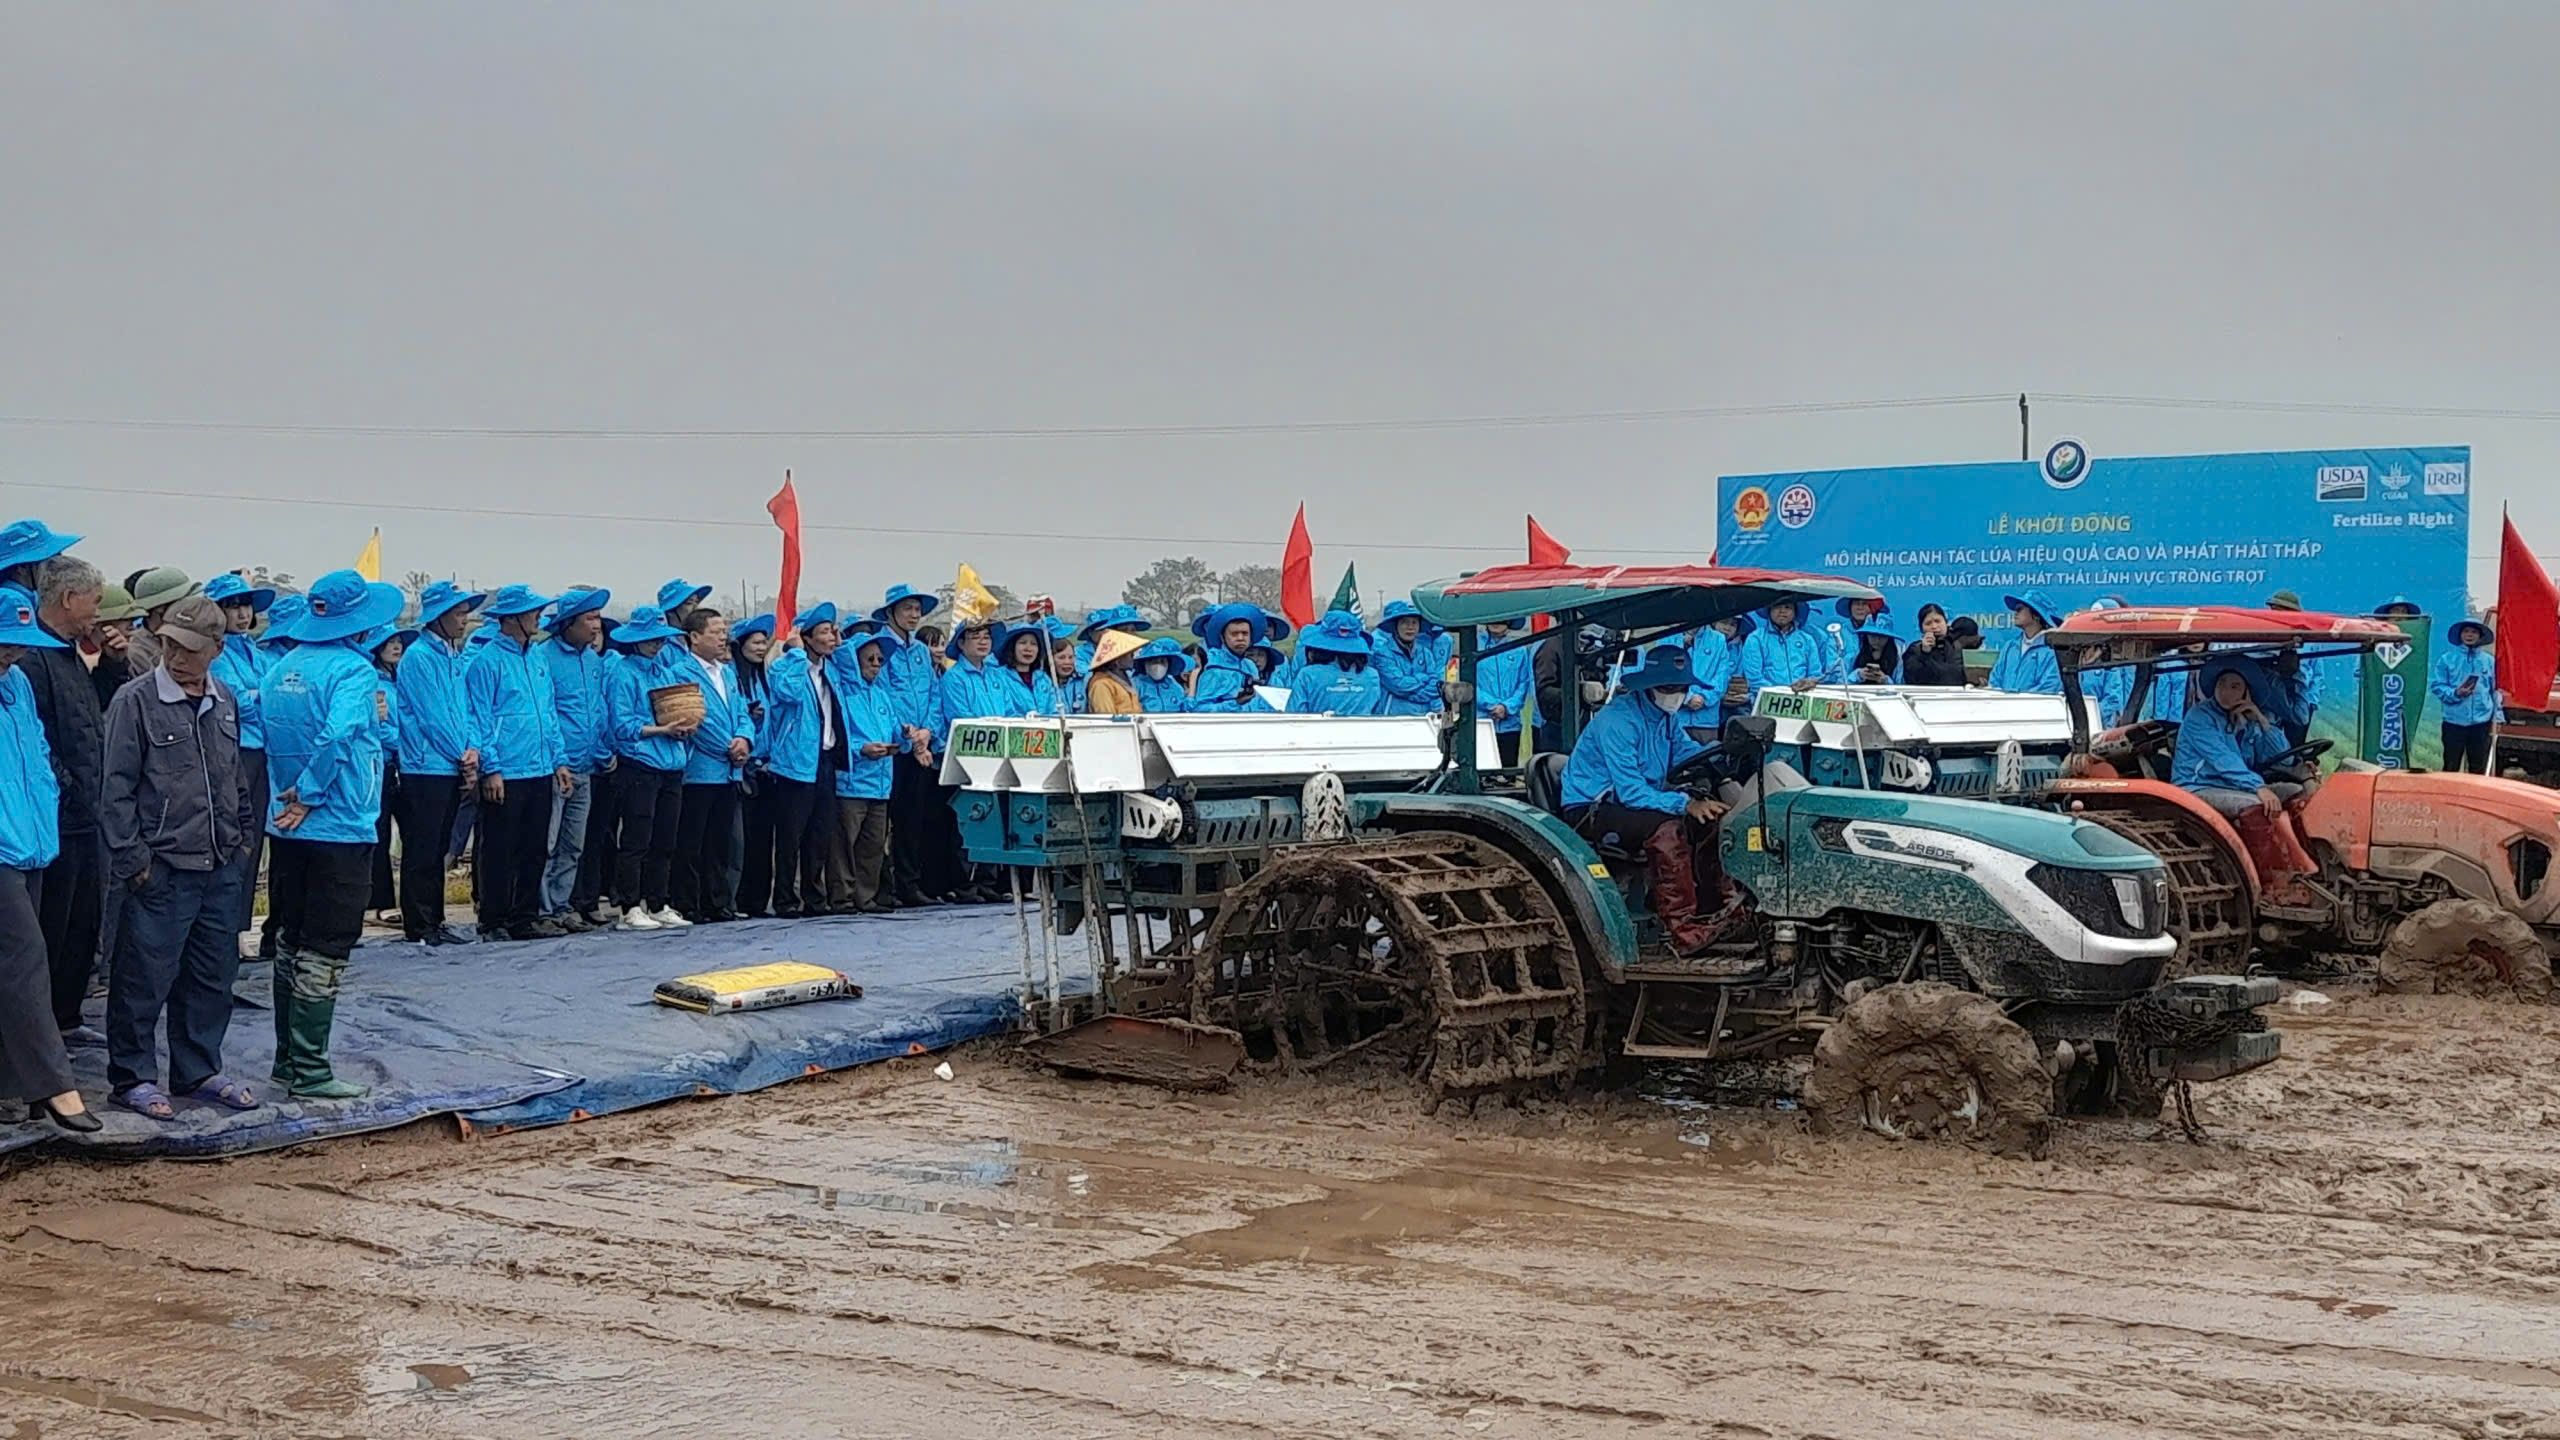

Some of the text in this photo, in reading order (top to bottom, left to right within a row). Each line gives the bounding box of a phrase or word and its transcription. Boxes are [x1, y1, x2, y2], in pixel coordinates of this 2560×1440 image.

[2320, 469, 2365, 482] USDA
[2428, 472, 2462, 486] IRRI
[1988, 512, 2131, 537] LỄ KHỞI ĐỘNG
[2332, 511, 2454, 528] Fertilize Right
[1824, 550, 1849, 566] MÔ
[1854, 549, 1894, 566] HÌNH
[1898, 551, 1942, 565] CANH
[1948, 547, 1976, 564] TÁC
[1981, 546, 2012, 563] LÚA
[2017, 545, 2057, 565] HIỆU
[2062, 543, 2099, 564] QUẢ
[2104, 546, 2140, 561] CAO
[2145, 542, 2167, 561] VÀ
[2173, 542, 2218, 560] PHÁT
[1887, 572, 1905, 587] ÁN
[2018, 570, 2053, 585] PHÁT
[2227, 569, 2266, 586] TRỌT
[1767, 697, 1848, 720] HPR 12
[2380, 673, 2405, 751] SANG
[961, 728, 1045, 754] HPR 12
[1906, 841, 1955, 859] ARBOS
